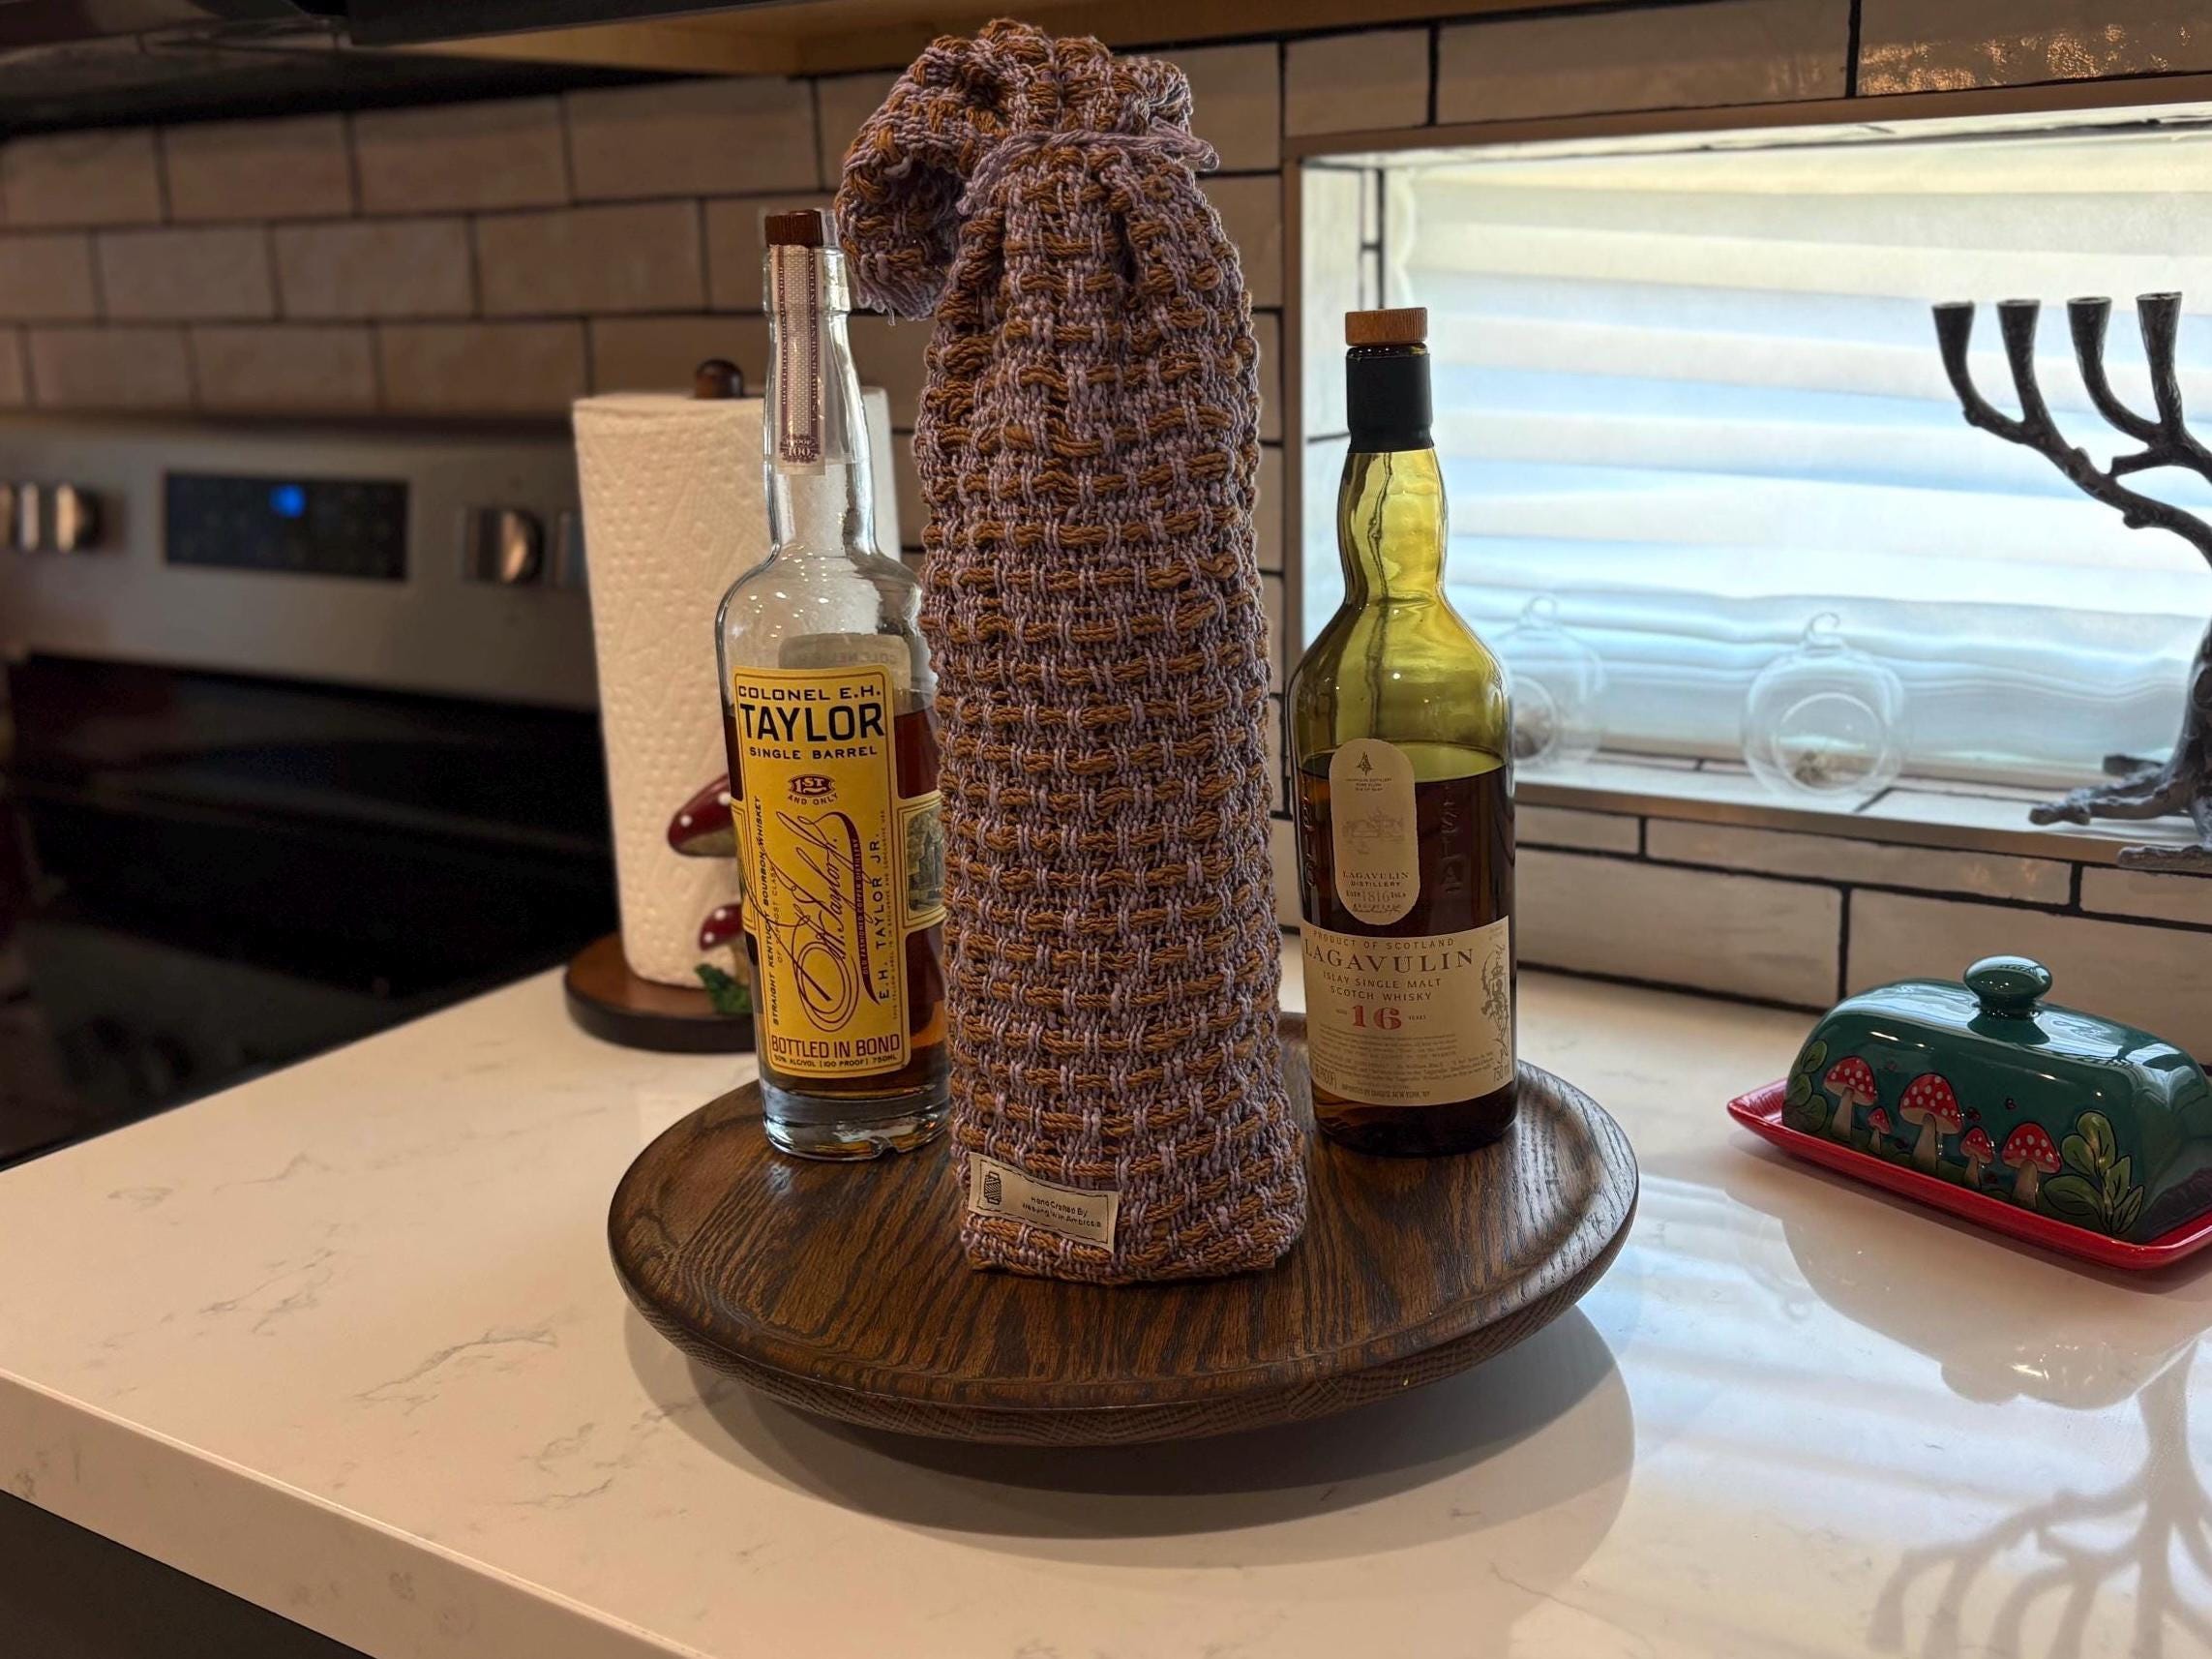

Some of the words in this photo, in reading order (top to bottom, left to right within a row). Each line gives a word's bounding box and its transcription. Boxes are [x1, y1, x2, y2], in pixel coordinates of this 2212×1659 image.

[738, 686, 830, 701] COLONEL
[840, 685, 881, 699] E.H.
[740, 703, 884, 741] TAYLOR
[750, 747, 801, 759] SINGLE
[813, 746, 878, 759] BARREL
[787, 795, 806, 804] AND
[813, 793, 838, 804] ONLY
[794, 777, 824, 792] 1ST
[754, 797, 764, 848] WHISKEY
[852, 837, 861, 881] DISTILLERY
[870, 833, 882, 863] JR.
[761, 852, 769, 906] BOURBON
[1343, 870, 1409, 880] LAGAVULIN
[854, 884, 863, 913] COPPER
[873, 877, 886, 950] TAYLOR
[764, 912, 775, 967] KENTUCKY
[857, 915, 867, 958] FASHIONED
[1313, 930, 1355, 946] PRODUCT
[1386, 938, 1454, 950] SCOTLAND
[1305, 939, 1474, 974] LAGAVULIN
[878, 961, 889, 999] E.H.
[1324, 971, 1349, 984] ISLAY
[1356, 978, 1400, 988] SINGLE
[1407, 979, 1442, 988] MALT
[1330, 986, 1374, 1000] SCOTCH
[1383, 992, 1432, 1001] WHISKY
[769, 973, 779, 1025] STRAIGHT
[1352, 1005, 1402, 1030] 16
[771, 1035, 829, 1058] BOTTLED
[834, 1041, 851, 1059] IN
[856, 1034, 900, 1056] BOND
